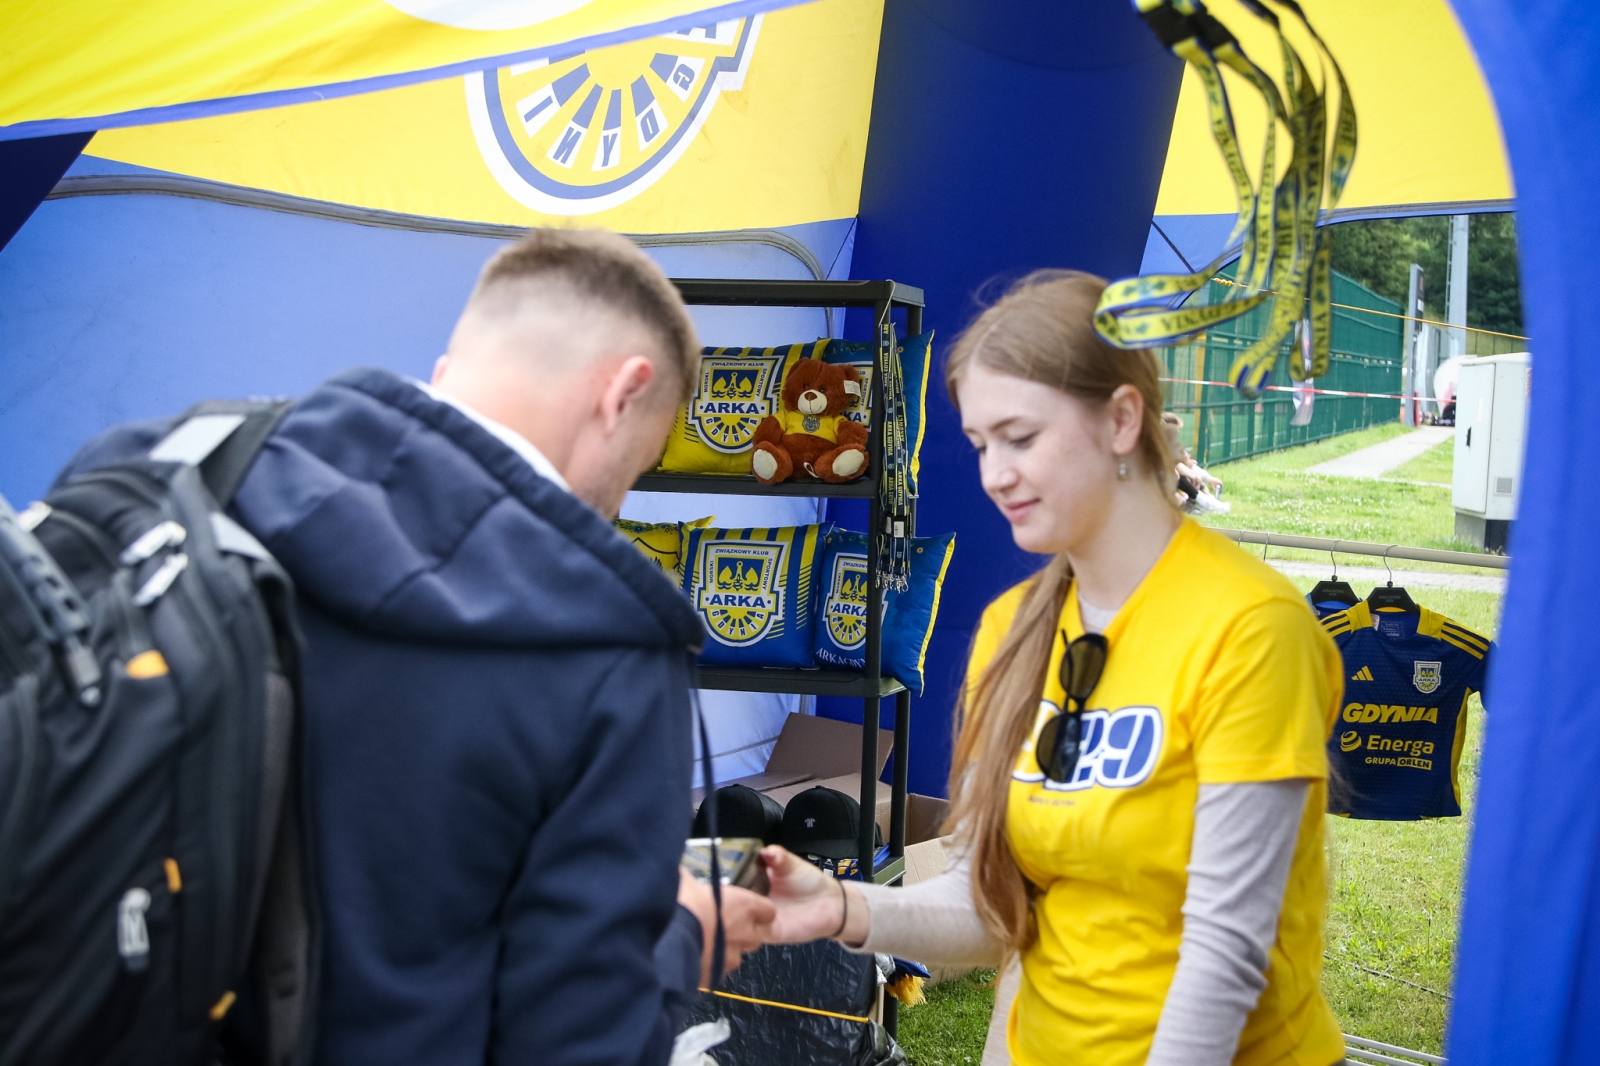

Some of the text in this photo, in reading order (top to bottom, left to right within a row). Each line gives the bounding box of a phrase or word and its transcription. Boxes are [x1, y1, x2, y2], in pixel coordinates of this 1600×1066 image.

[756, 368, 768, 396] SPORTOWY
[703, 402, 760, 414] ARKA
[842, 411, 863, 423] KA
[706, 417, 758, 442] GDYNIA
[762, 557, 773, 590] SPORTOWY
[709, 594, 766, 608] ARKA
[711, 610, 764, 636] GDYNIA
[1342, 702, 1439, 724] GDYNIA
[1366, 734, 1435, 757] Energa
[1365, 756, 1430, 769] GRUPA ORLEN
